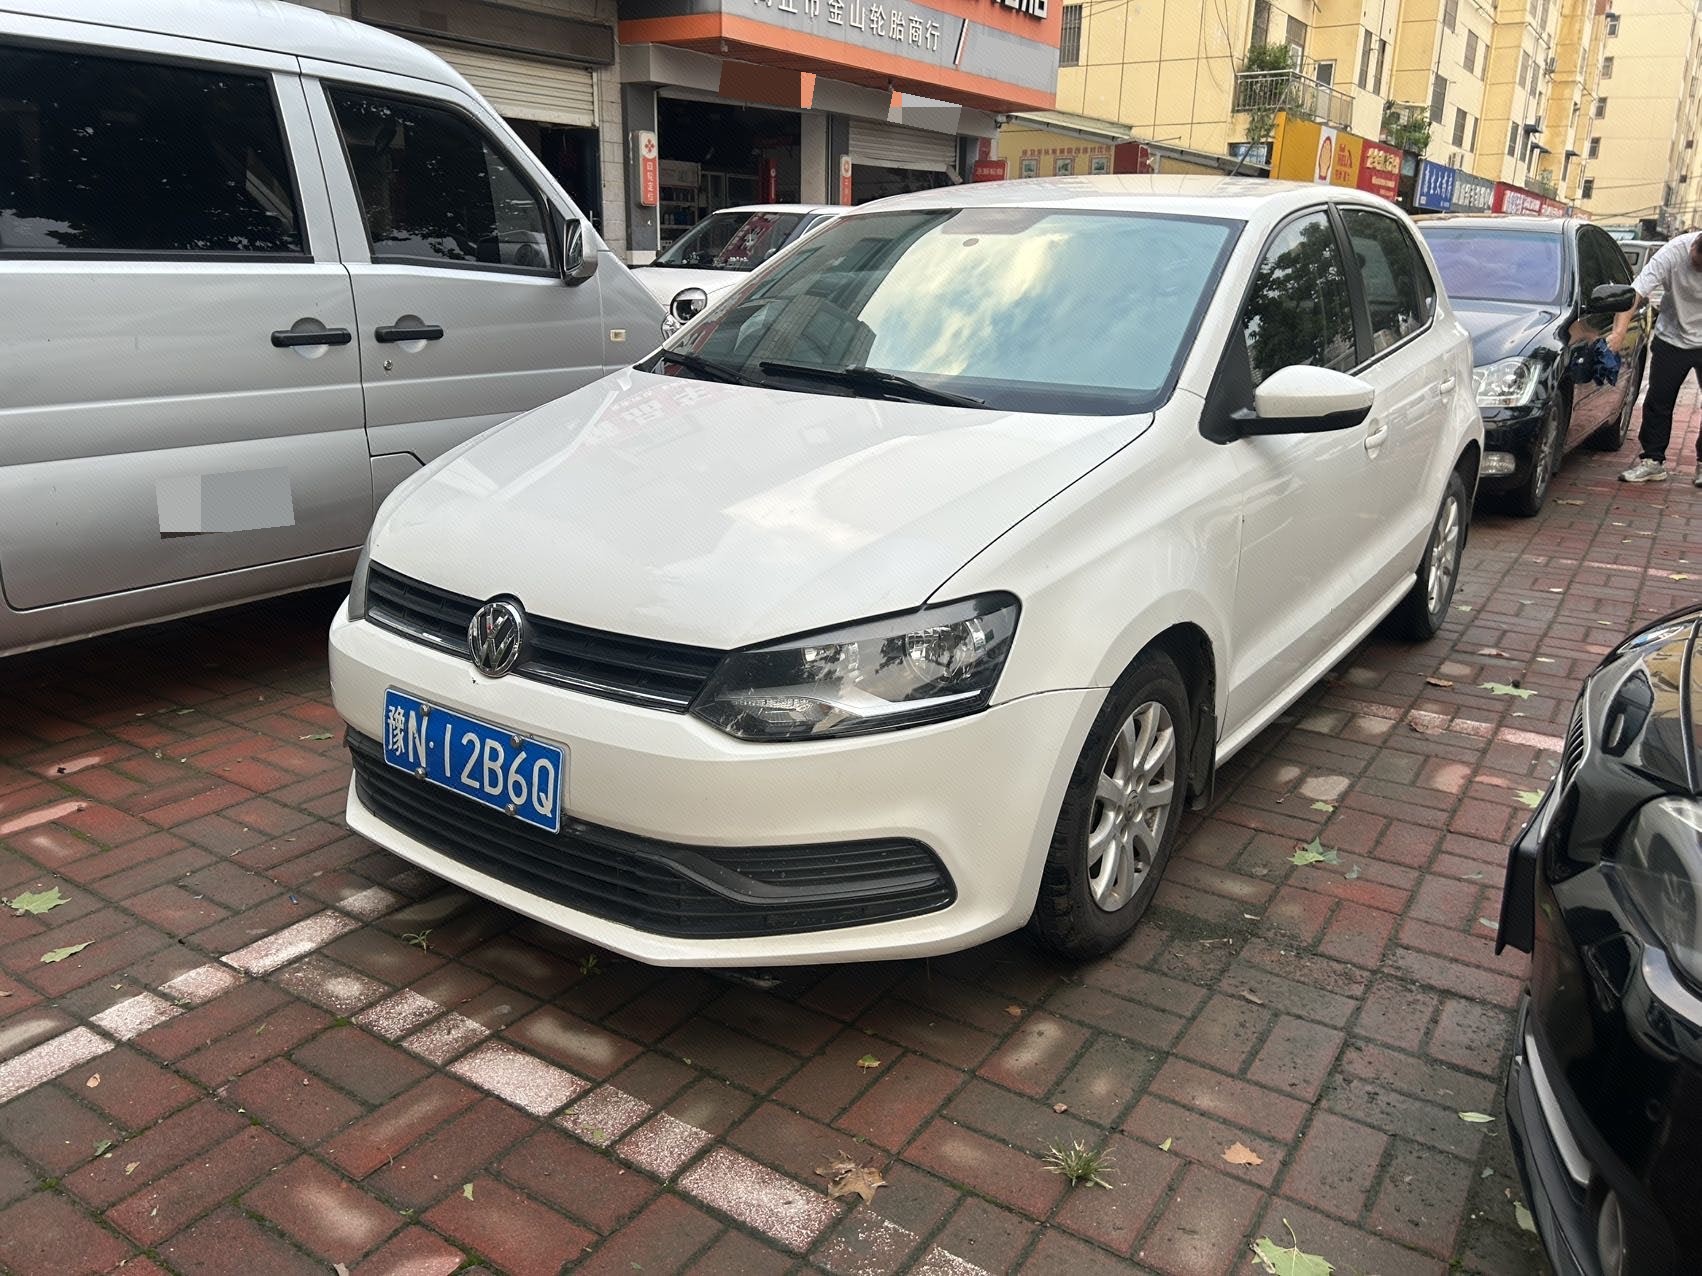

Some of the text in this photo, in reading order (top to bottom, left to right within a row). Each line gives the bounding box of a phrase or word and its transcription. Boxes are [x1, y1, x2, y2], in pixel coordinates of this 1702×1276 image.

[754, 0, 941, 52] 市金山轮胎商行
